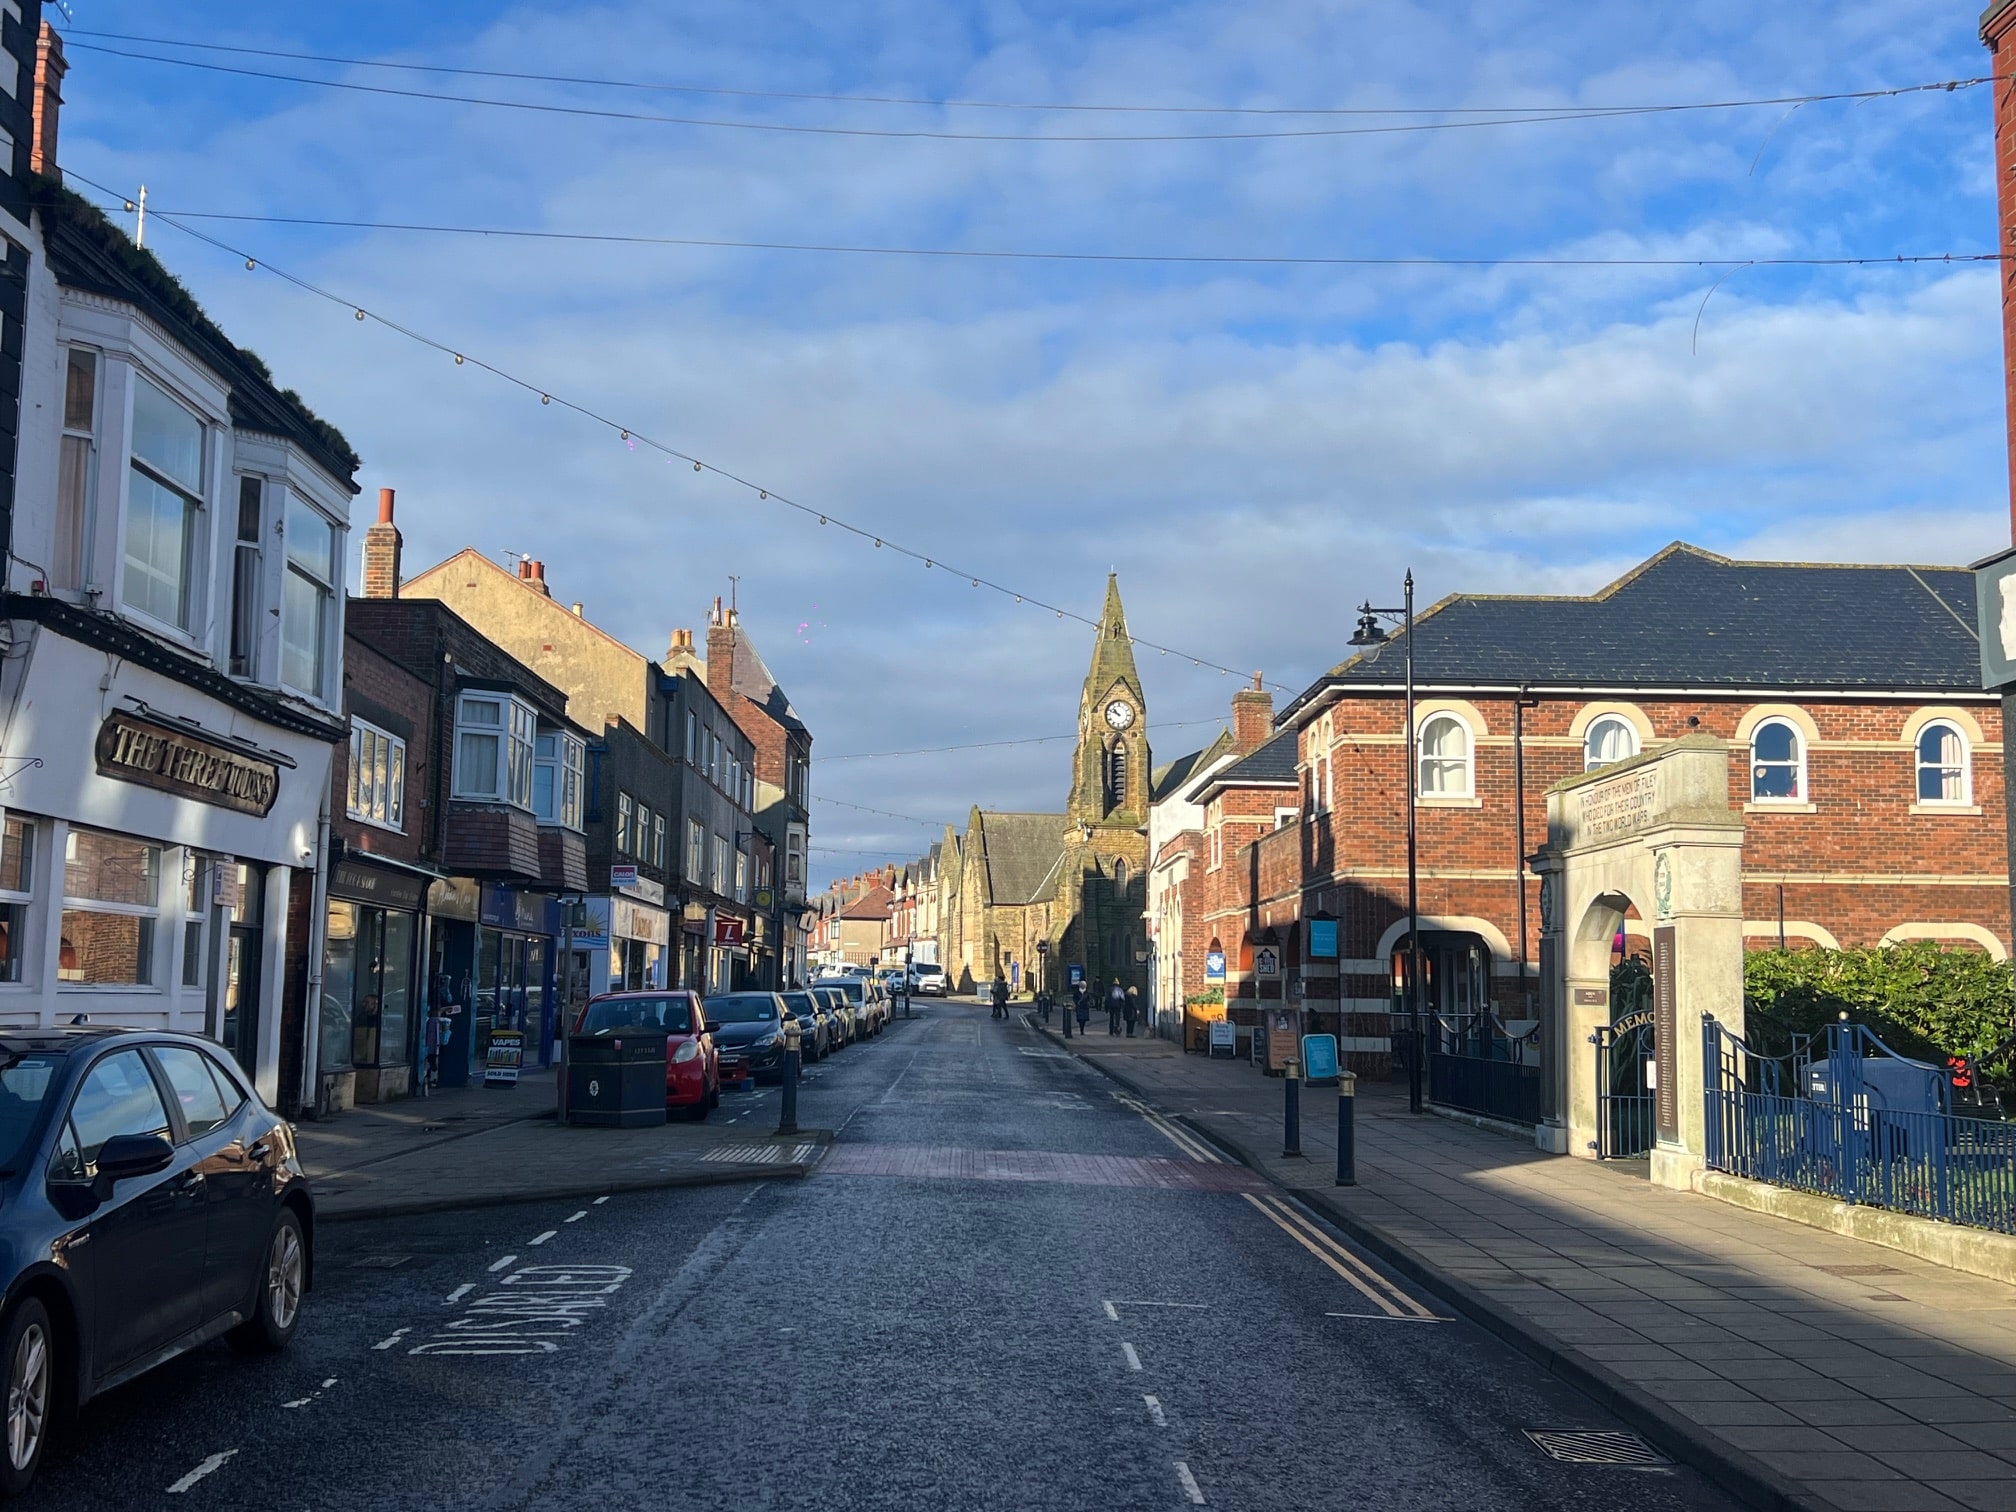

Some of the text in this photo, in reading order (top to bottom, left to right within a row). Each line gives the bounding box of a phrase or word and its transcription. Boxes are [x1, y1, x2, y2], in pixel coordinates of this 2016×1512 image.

[112, 724, 274, 806] THE THREE TUNS
[1580, 774, 1656, 808] IN HONOUR OF THE MEN OF FILEY
[1582, 791, 1655, 822] WHO DIED FOR THEIR COUNTRY
[1587, 825, 1592, 836] IN
[1593, 822, 1602, 835] THE
[1603, 819, 1613, 832] TWO
[1614, 814, 1632, 830] WORLD
[492, 1038, 521, 1046] VAPES
[408, 1265, 633, 1355] DISABLED
